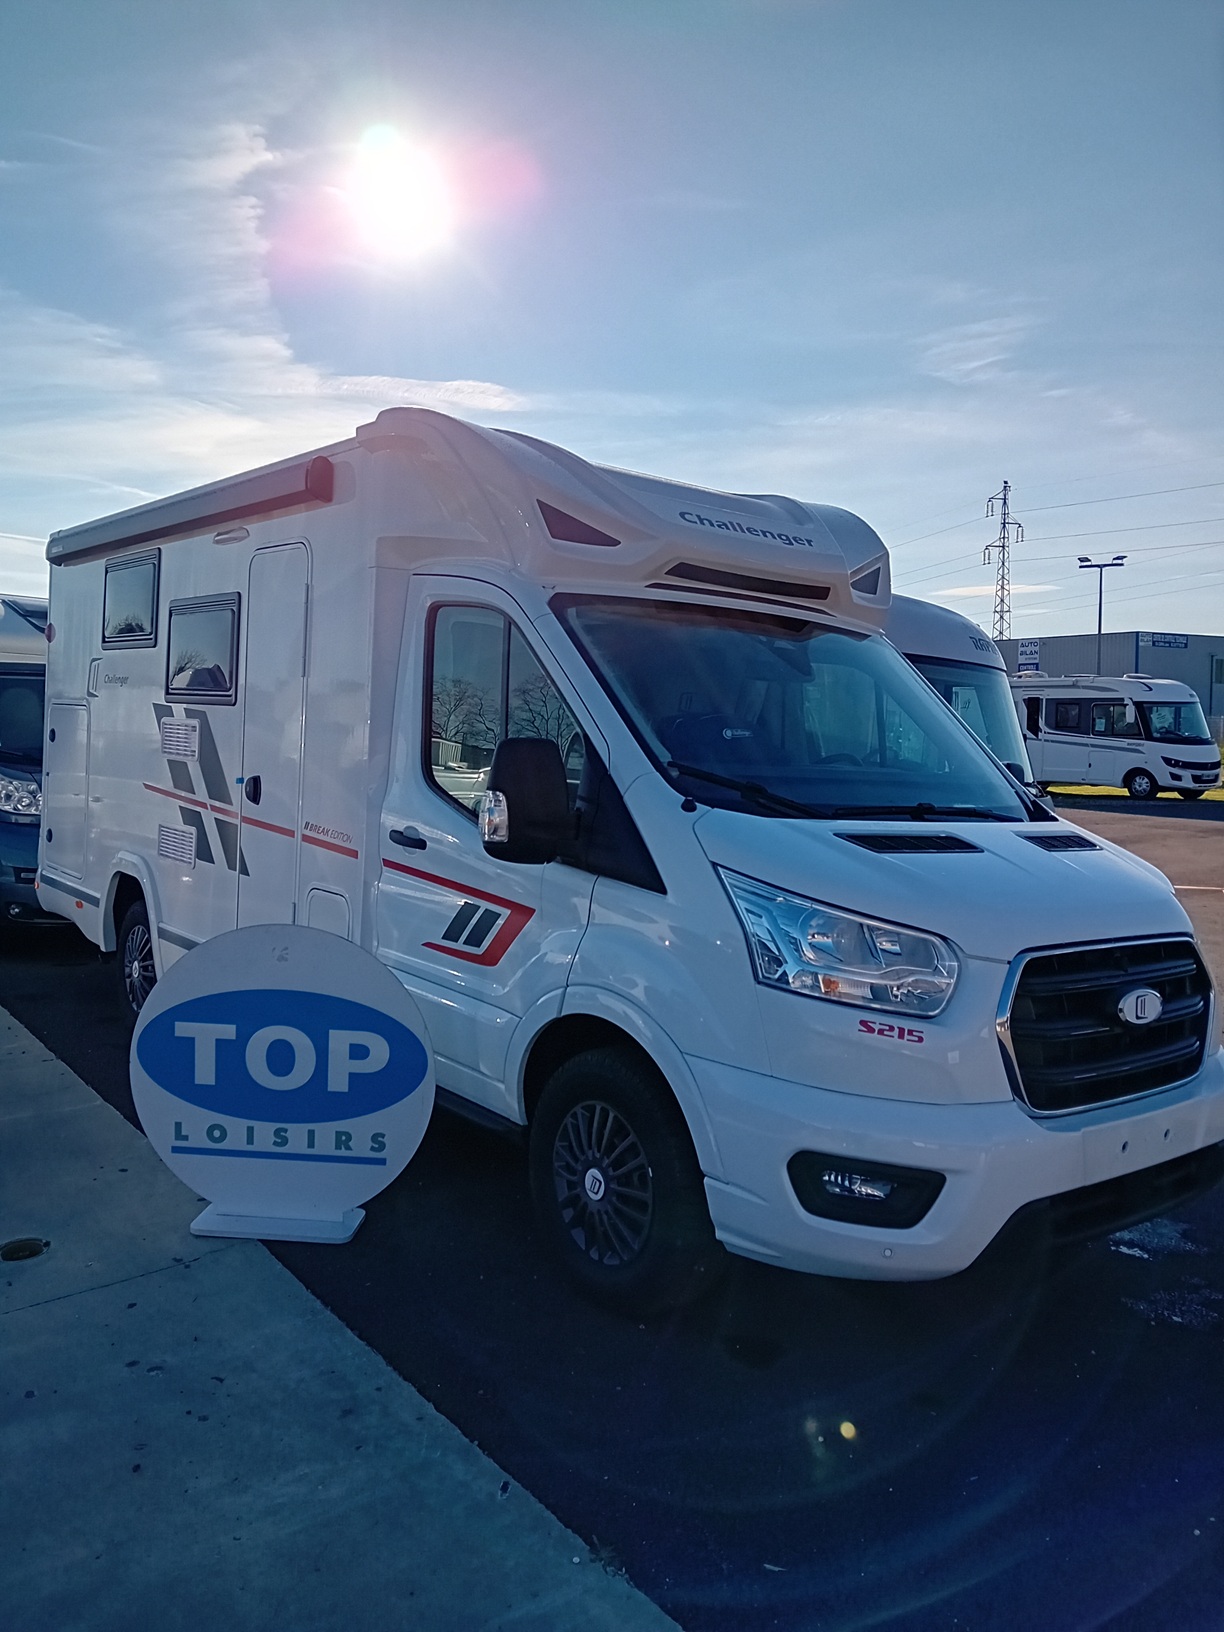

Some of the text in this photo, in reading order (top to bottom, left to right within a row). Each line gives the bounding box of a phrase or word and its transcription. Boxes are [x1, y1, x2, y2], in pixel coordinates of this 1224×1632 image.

[678, 511, 814, 547] Challenger
[309, 823, 353, 844] BREAK EDITION
[858, 1019, 925, 1044] S215
[174, 1021, 390, 1092] TOP
[174, 1121, 387, 1153] LOISIRS
